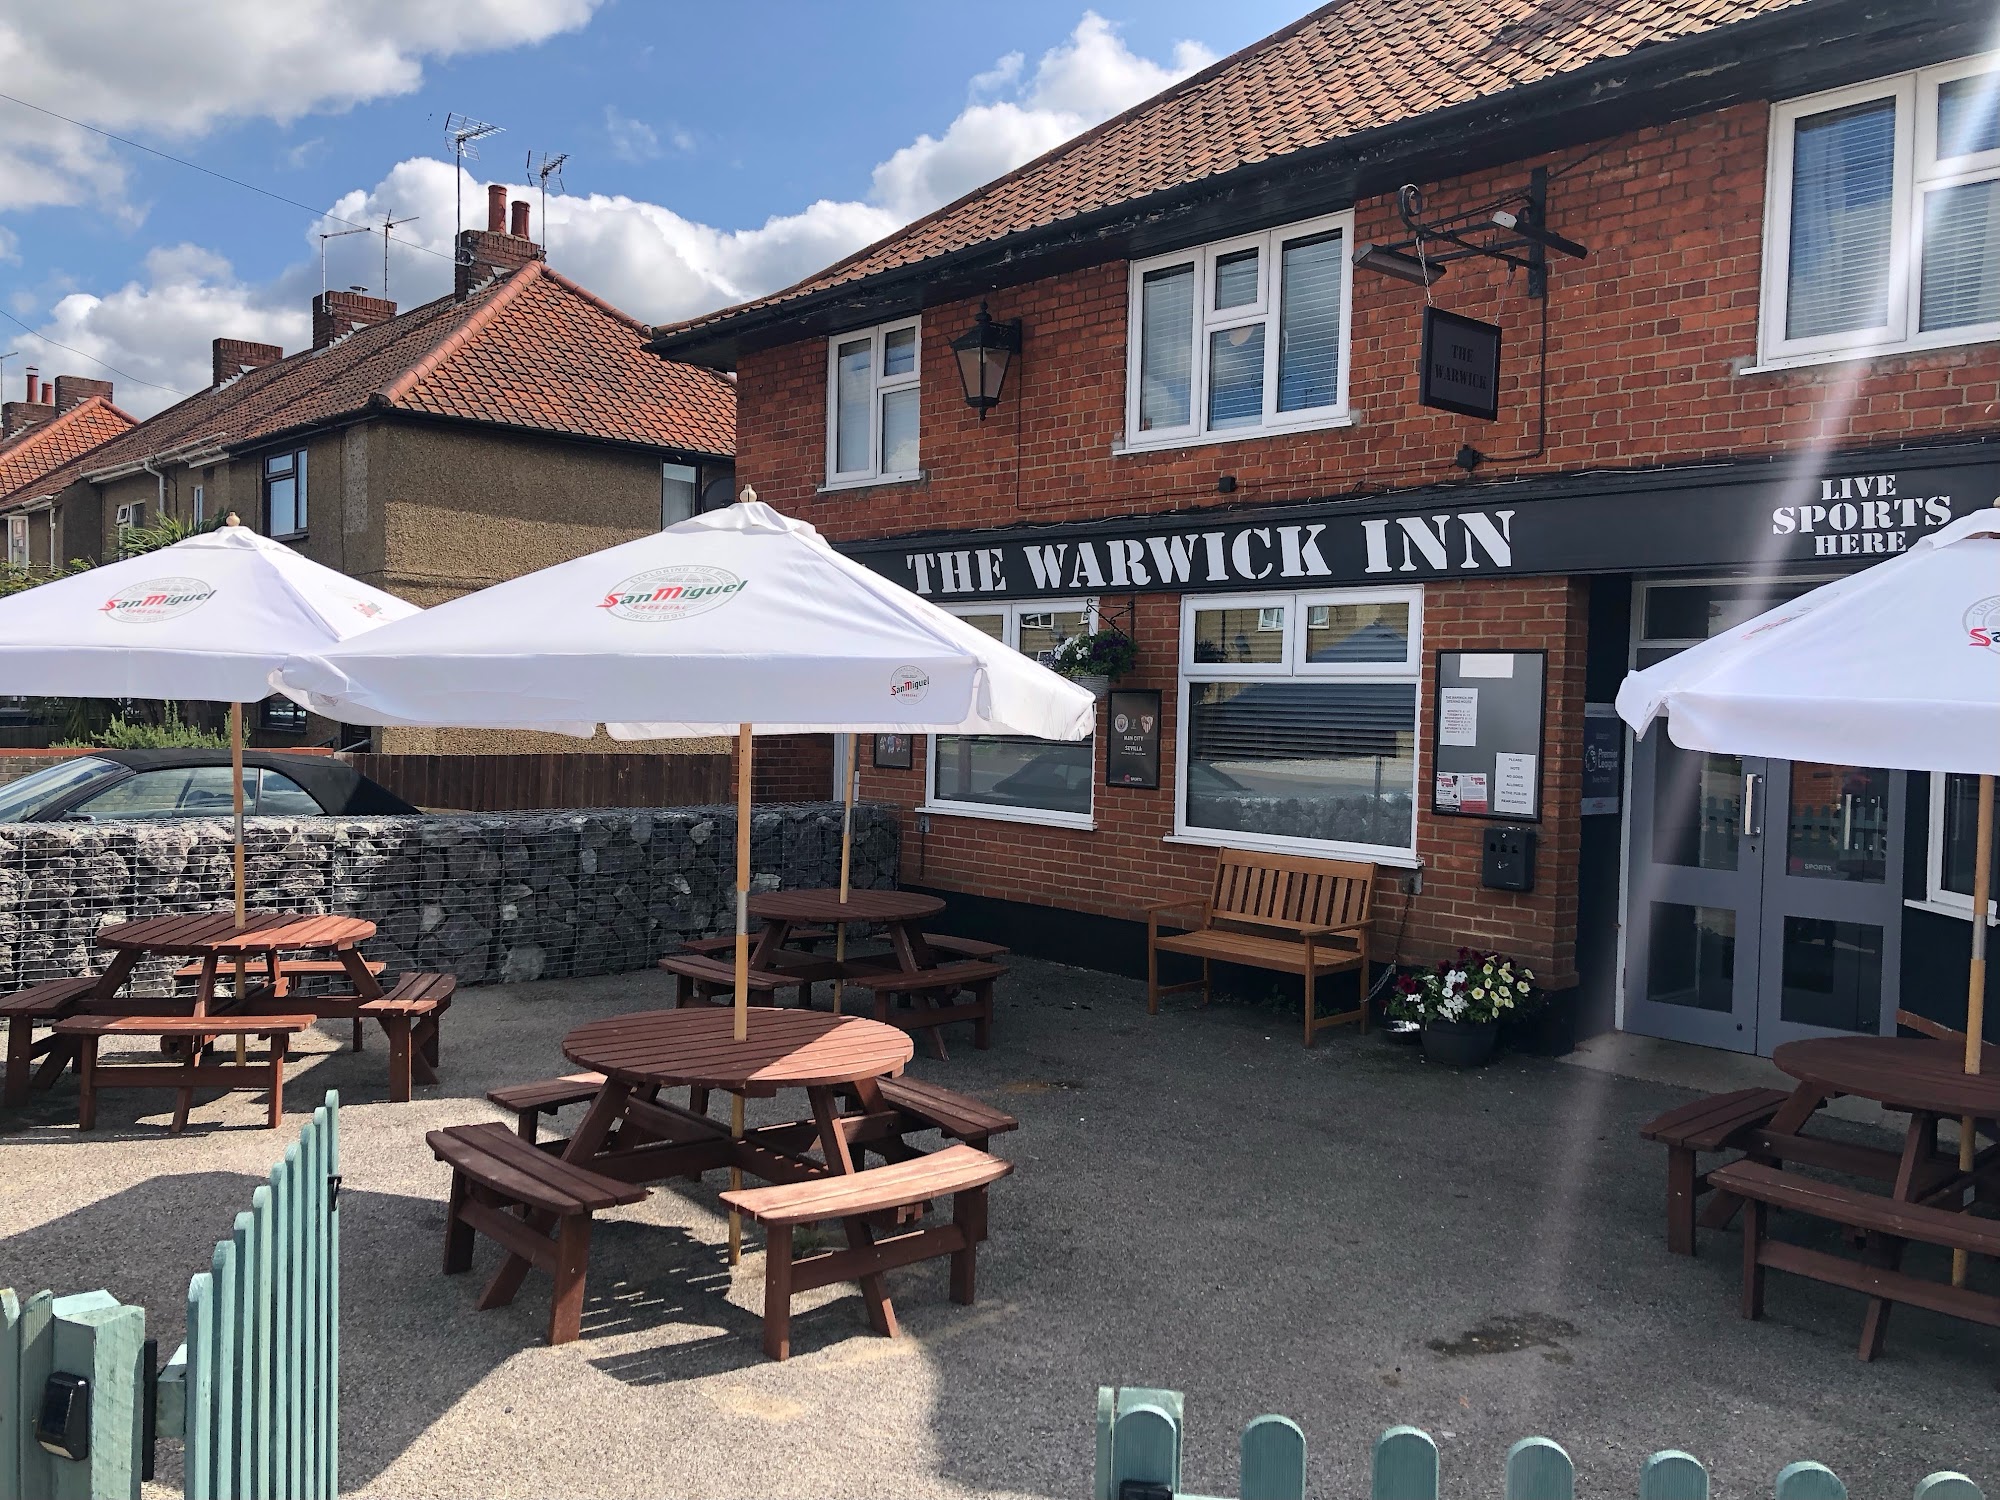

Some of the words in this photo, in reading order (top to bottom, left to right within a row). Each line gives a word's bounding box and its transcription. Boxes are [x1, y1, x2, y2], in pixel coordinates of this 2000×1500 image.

[1452, 344, 1473, 363] THE
[1435, 364, 1487, 389] WARWICK
[1821, 474, 1897, 500] LIVE
[1772, 496, 1951, 535] SPORTS
[906, 548, 1007, 594] THE
[1022, 524, 1332, 590] WARWICK
[1361, 510, 1517, 574] INN
[1814, 531, 1908, 556] HERE
[1597, 760, 1618, 770] League
[1598, 748, 1618, 758] Premier
[1804, 863, 1832, 871] SPORTS
